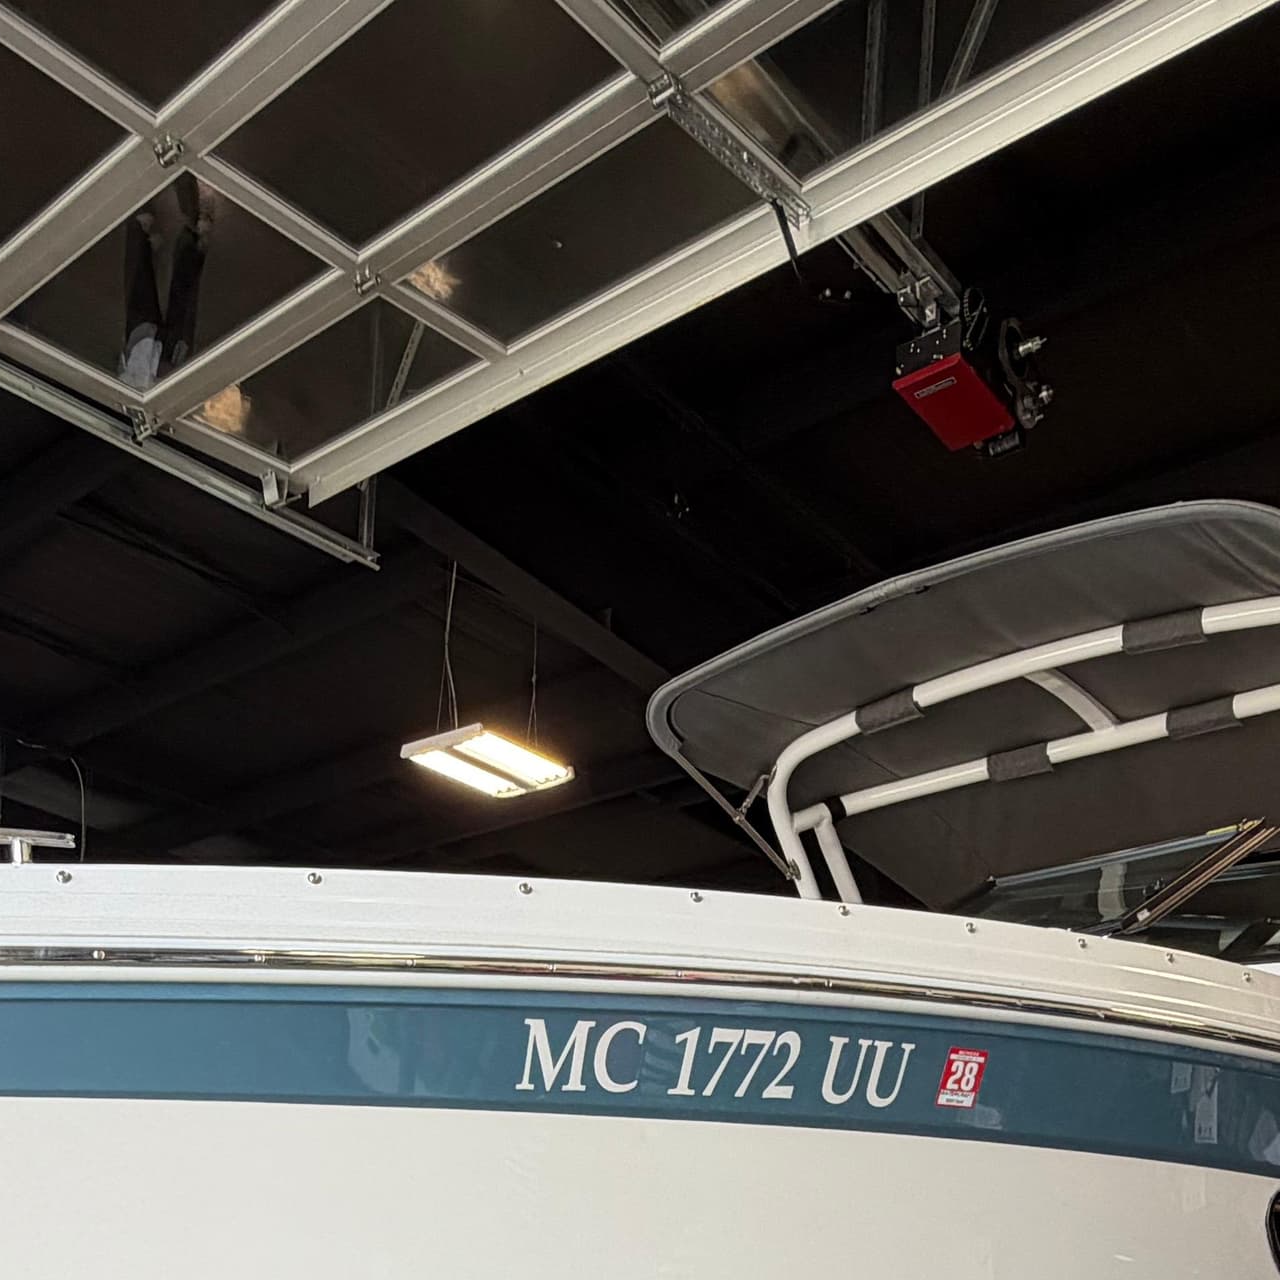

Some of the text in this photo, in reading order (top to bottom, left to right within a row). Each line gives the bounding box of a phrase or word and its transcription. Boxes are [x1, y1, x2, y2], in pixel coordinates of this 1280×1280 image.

[514, 1018, 917, 1108] MC 1772 UU
[946, 1060, 980, 1092] 28
